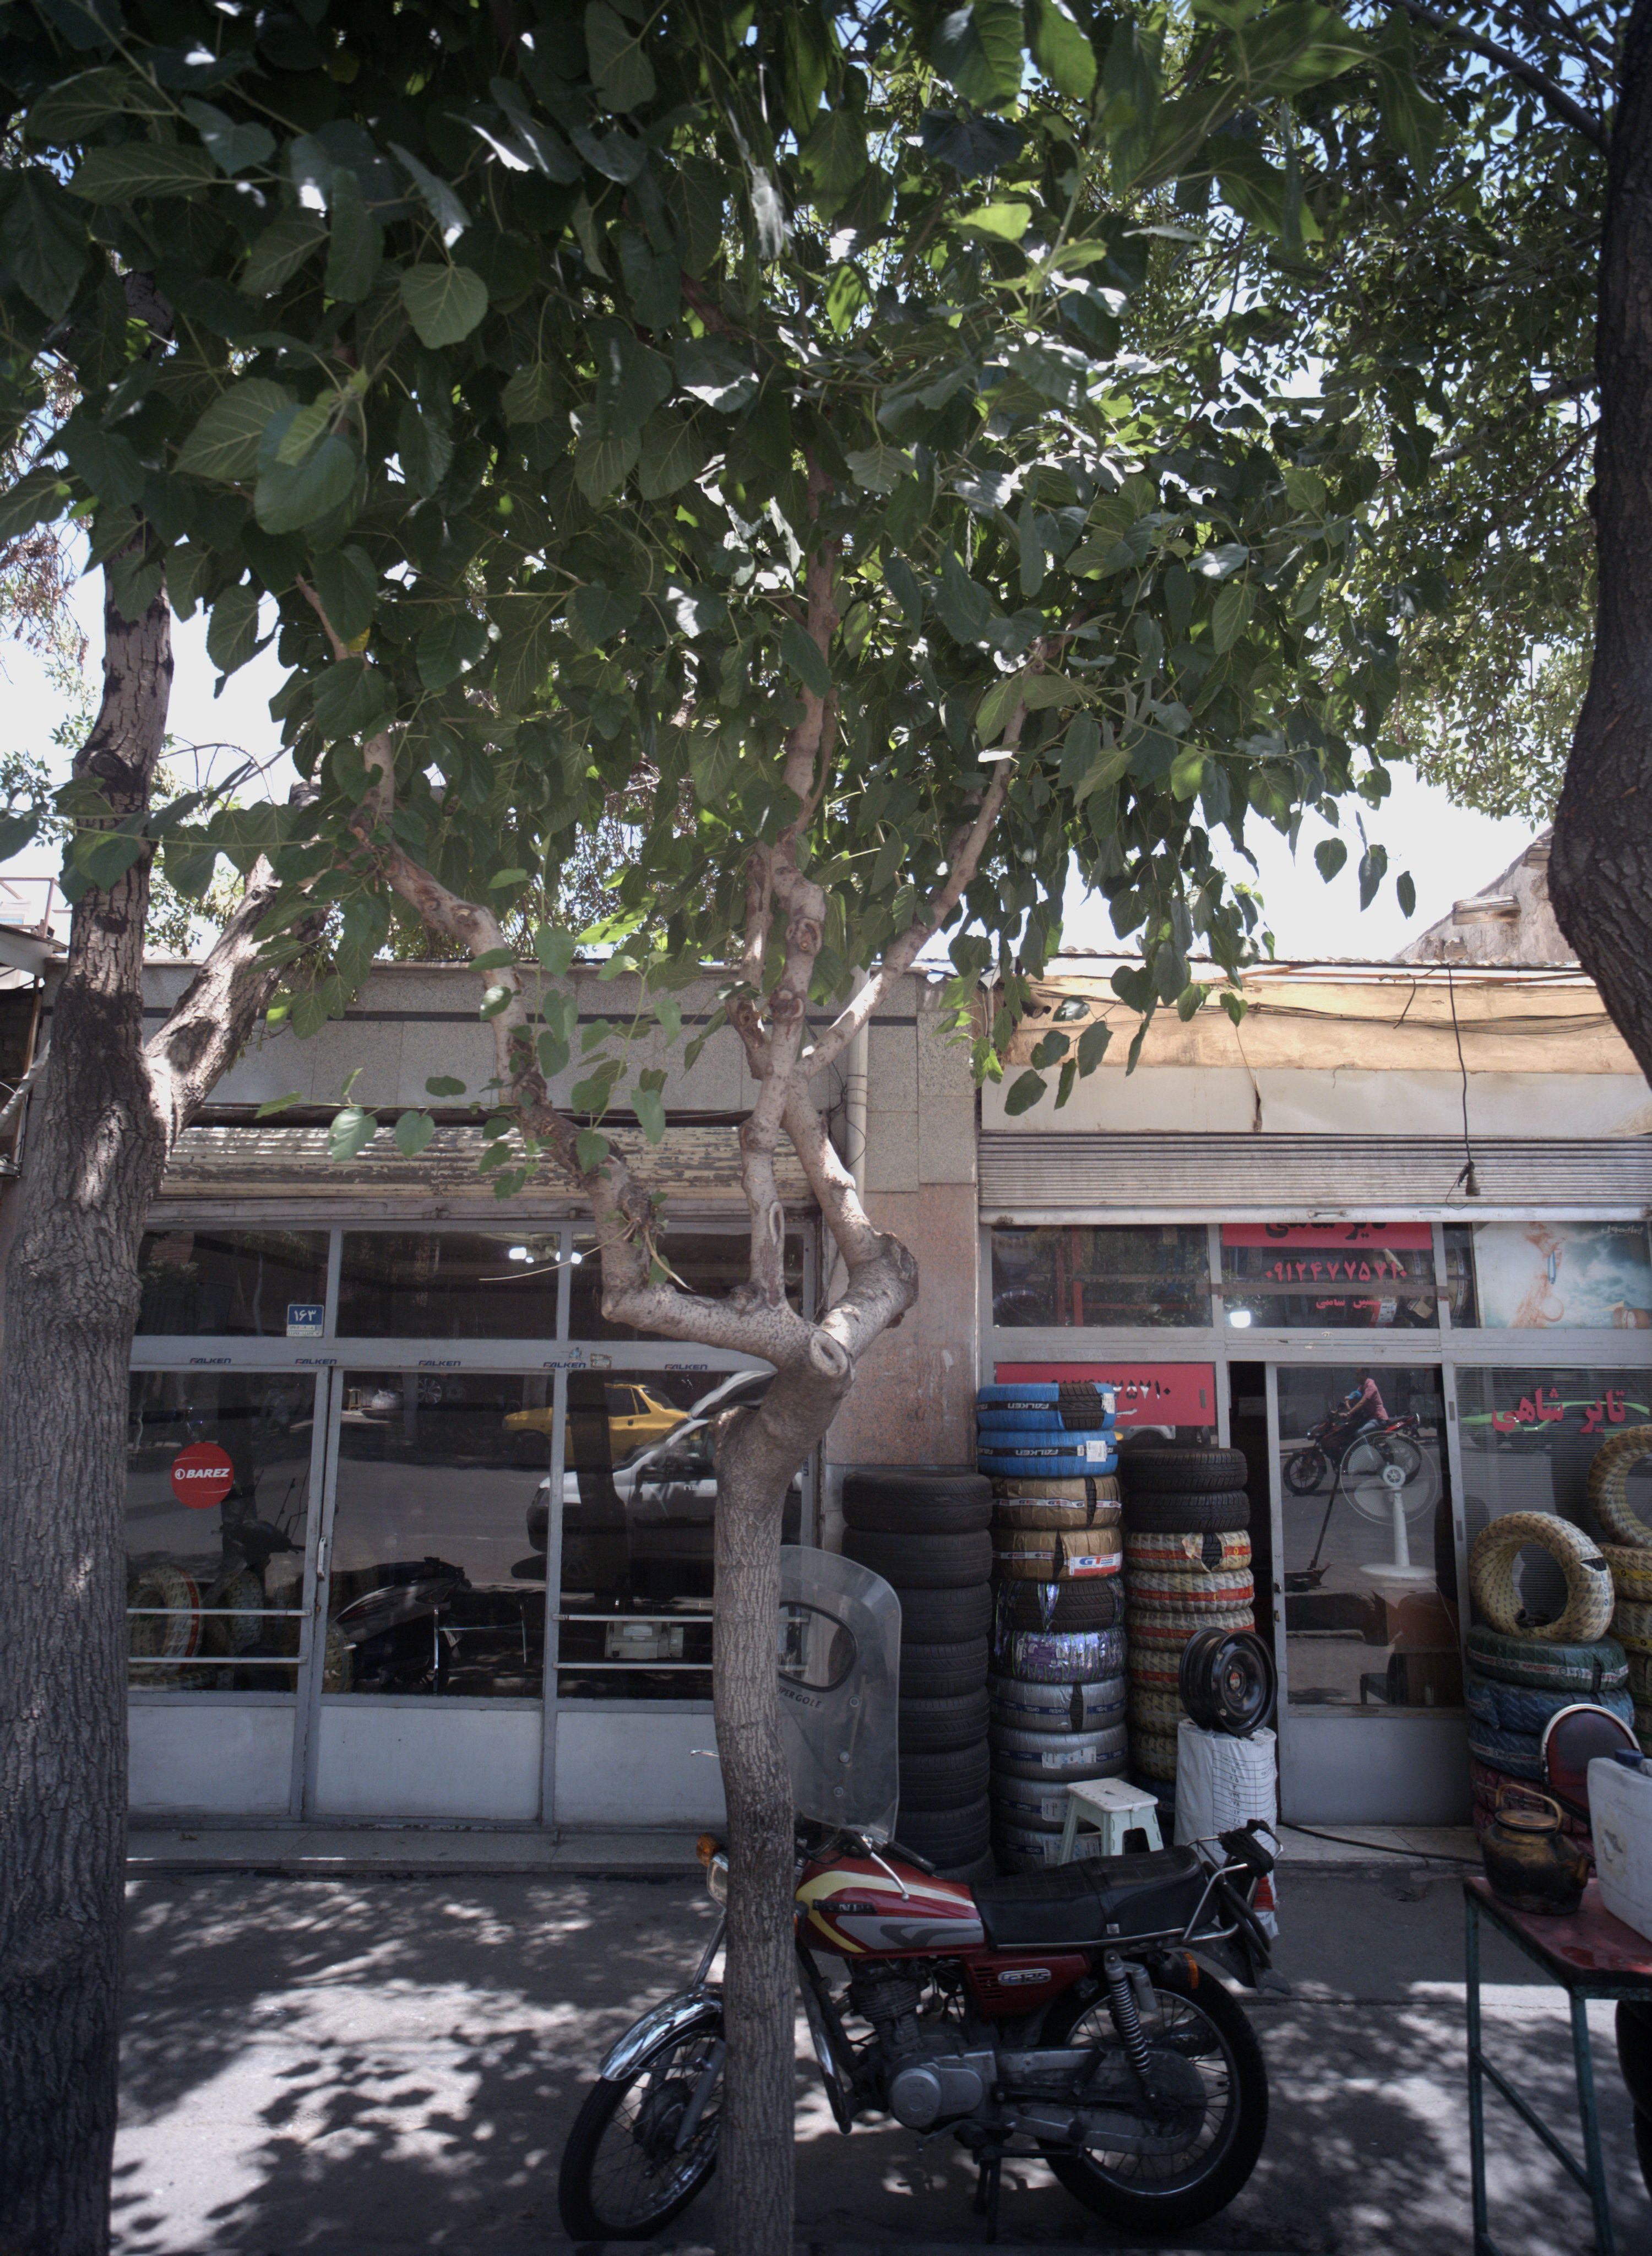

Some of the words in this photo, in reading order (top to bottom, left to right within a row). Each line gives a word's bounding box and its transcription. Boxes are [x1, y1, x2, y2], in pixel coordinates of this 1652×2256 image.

[1265, 1261, 1408, 1282] ۰۹۱۲۴۷۷۵۷۱۰
[294, 1310, 317, 1321] ۱۶۳
[1492, 1387, 1564, 1432] شاهی
[1579, 1389, 1626, 1434] تایر
[186, 1468, 230, 1478] BAREZ
[1079, 1557, 1102, 1565] GT
